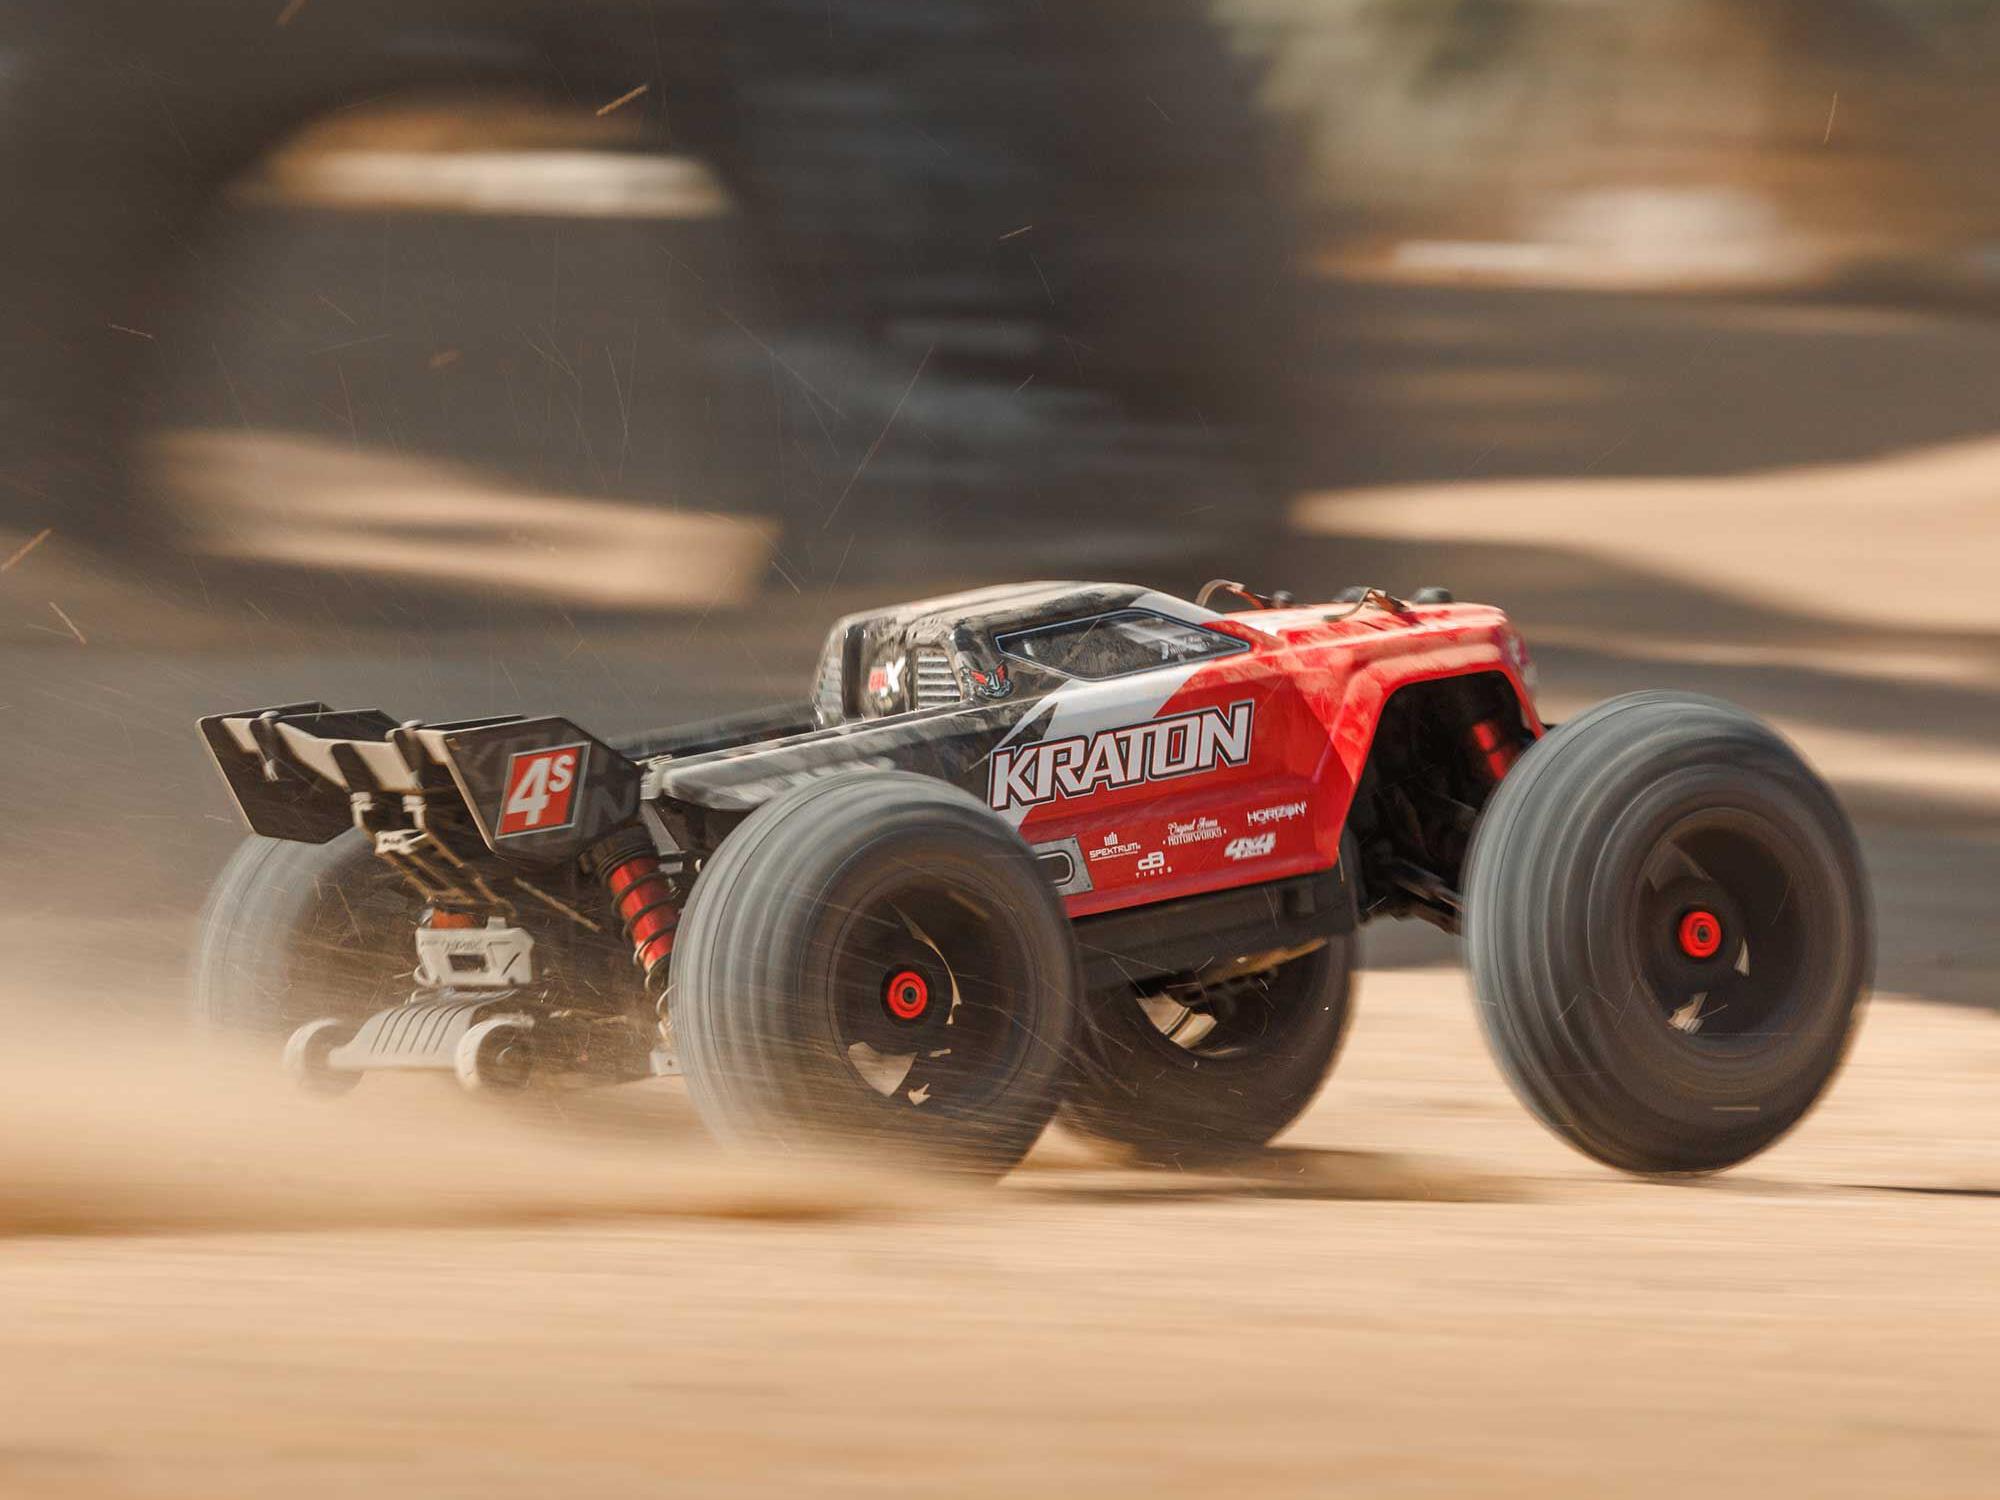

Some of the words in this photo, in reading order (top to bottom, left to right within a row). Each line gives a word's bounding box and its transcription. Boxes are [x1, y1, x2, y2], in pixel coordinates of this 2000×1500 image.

[989, 701, 1252, 811] KRATON
[506, 754, 577, 826] 4S
[1246, 801, 1307, 823] HORIZON
[1089, 842, 1141, 859] SPEKTRUM
